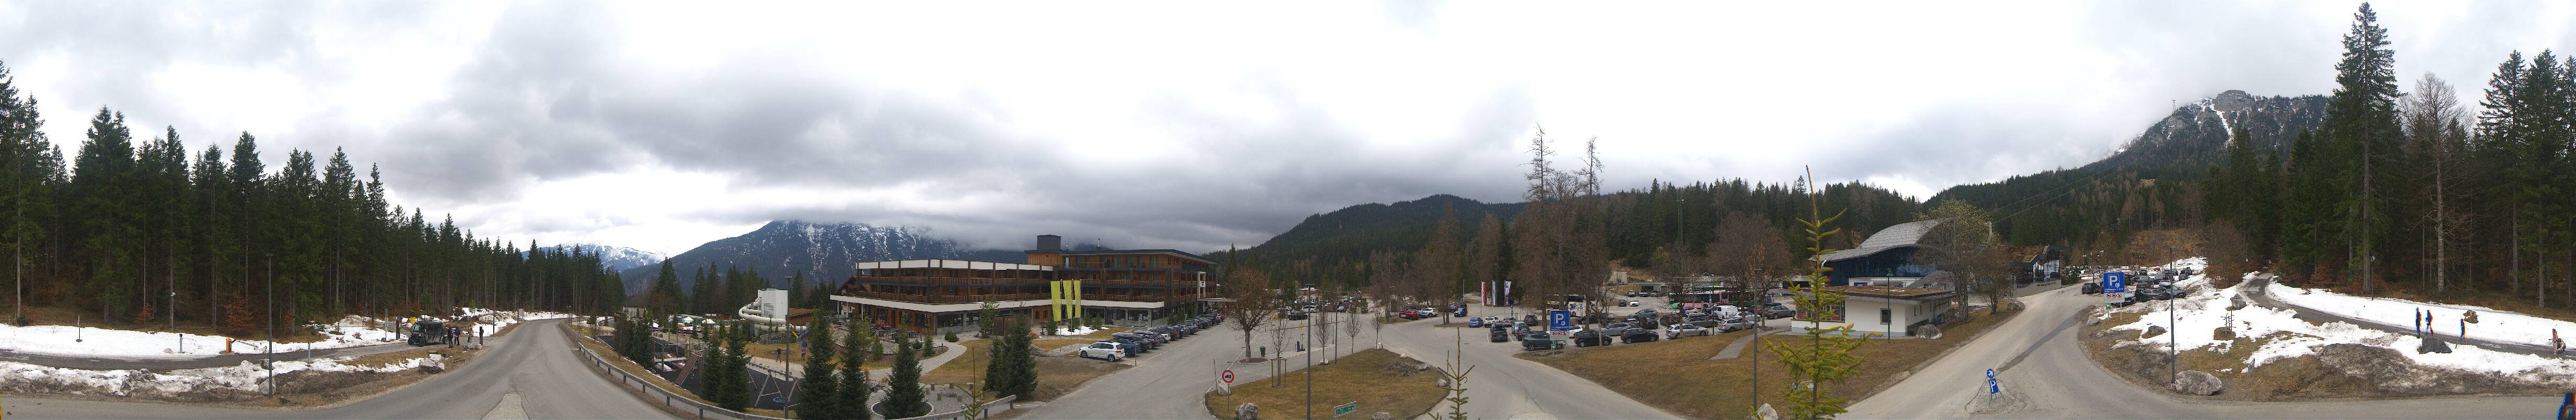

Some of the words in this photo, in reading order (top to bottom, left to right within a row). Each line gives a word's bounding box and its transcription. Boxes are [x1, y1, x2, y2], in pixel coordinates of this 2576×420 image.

[2109, 275, 2118, 286] P
[1555, 313, 1564, 324] P
[1990, 380, 1996, 393] P
